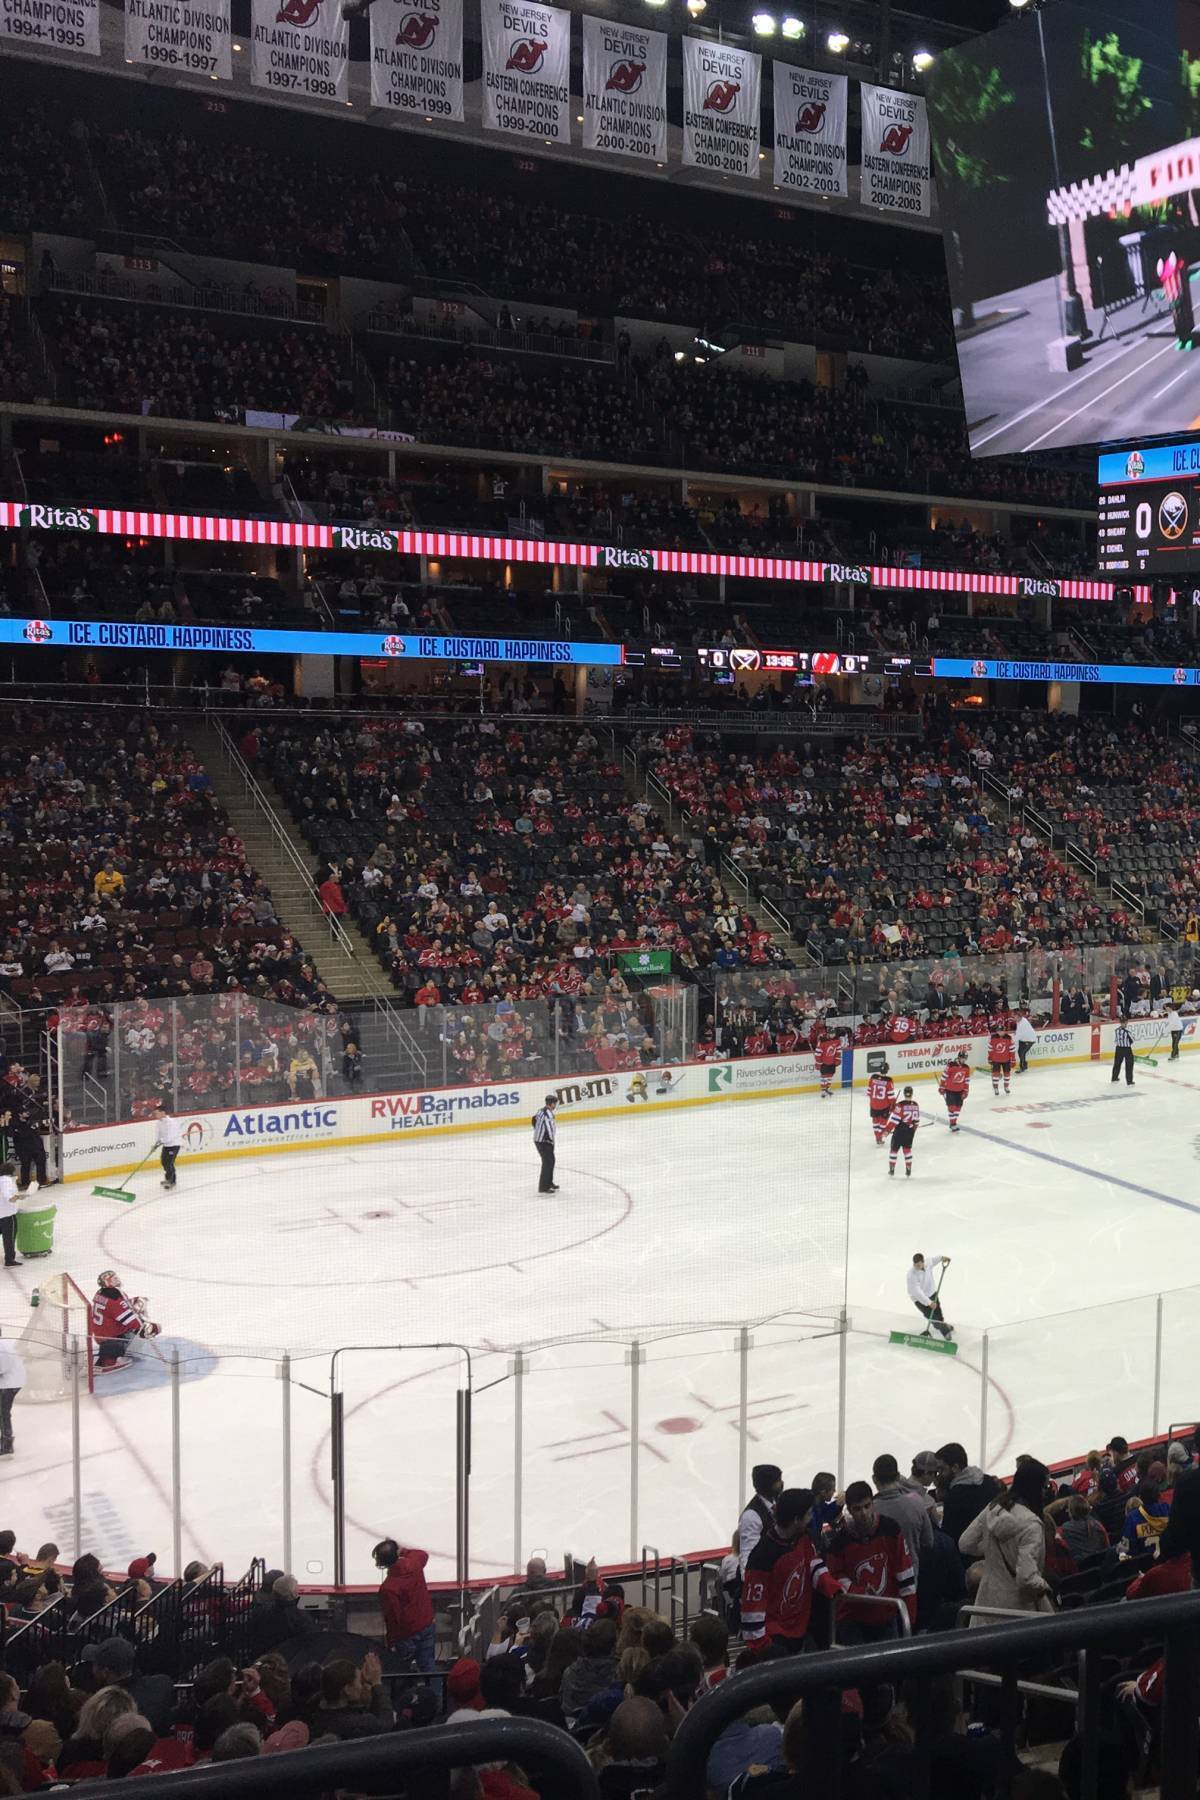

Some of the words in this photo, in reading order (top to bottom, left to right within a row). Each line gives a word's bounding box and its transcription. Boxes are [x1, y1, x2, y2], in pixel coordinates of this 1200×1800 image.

[3, 0, 85, 28] CHAMPIONS
[129, 2, 181, 26] ATLANTIC
[184, 9, 230, 34] DIVISION
[499, 3, 520, 15] NEW
[520, 8, 553, 23] JERSEY
[4, 18, 86, 47] 1994-1995
[503, 15, 549, 38] DEVILS
[600, 26, 619, 38] NEW
[620, 31, 650, 45] JERSEY
[148, 25, 212, 51] CHAMPIONS
[255, 24, 301, 51] ATLANTIC
[304, 34, 348, 59] DIVISION
[604, 38, 647, 60] DEVILS
[143, 45, 218, 72] 1996-1997
[270, 52, 330, 77] CHAMPIONS
[374, 47, 418, 73] ATLANTIC
[420, 56, 461, 79] DIVISION
[698, 47, 717, 59] NEW
[717, 52, 746, 66] JERSEY
[702, 59, 742, 80] DEVILS
[789, 71, 805, 84] NEW
[806, 76, 833, 89] JERSEY
[266, 70, 337, 96] 1997-1998
[391, 71, 447, 97] CHAMPIONS
[486, 72, 518, 93] EASTERN
[519, 79, 568, 104] CONFERENCE
[792, 84, 830, 102] DEVILS
[385, 90, 451, 115] 1998-1999
[495, 94, 559, 121] CHAMPIONS
[585, 93, 627, 116] ATLANTIC
[629, 101, 666, 122] DIVISION
[876, 92, 892, 104] NEW
[892, 98, 918, 110] JERSEY
[878, 104, 915, 123] DEVILS
[496, 114, 559, 137] 1999-2000
[600, 115, 652, 139] CHAMPIONS
[685, 111, 715, 133] EASTERN
[715, 118, 758, 141] CONFERENCE
[596, 134, 657, 156] 2000-2001
[694, 133, 749, 158] CHAMPIONS
[776, 133, 813, 154] ATLANTIC
[813, 142, 846, 160] DIVISION
[695, 152, 748, 174] 2000-2001
[788, 155, 833, 177] CHAMPIONS
[863, 154, 890, 174] EASTERN
[890, 161, 929, 181] CONFERENCE
[782, 171, 840, 193] 2002-2003
[870, 174, 922, 197] CHAMPIONS
[871, 191, 922, 212] 2002-2003
[1173, 450, 1189, 472] ICE.
[30, 503, 91, 531] Rita's
[1136, 502, 1152, 538] 0
[340, 526, 393, 551] Rita's
[605, 547, 650, 570] Rita's
[829, 563, 868, 584] Rita's
[1024, 577, 1057, 597] Rita's
[68, 622, 95, 644] ICE.
[98, 624, 170, 647] CUSTARD.
[172, 626, 256, 650] HAPPINESS.
[418, 637, 442, 657] ICE.
[443, 638, 503, 659] CUSTARD.
[504, 639, 574, 662] HAPPINESS.
[713, 652, 722, 666] 0
[765, 654, 794, 667] 13:35
[996, 662, 1011, 678] ICE.
[1012, 663, 1053, 680] CUSTARD.
[1053, 665, 1101, 681] HAPPINESS.
[895, 1020, 909, 1033] 39
[1043, 1032, 1075, 1043] COAST
[898, 1048, 931, 1059] STREAM
[944, 1043, 973, 1053] GAMES
[1059, 1044, 1075, 1054] GAS
[736, 1067, 776, 1079] Riverside
[776, 1063, 795, 1074] Oral
[907, 1060, 923, 1070] LIVE
[872, 1084, 887, 1099] 13
[223, 1105, 337, 1138] Atlantic
[391, 1112, 454, 1130] HEALTH
[745, 1583, 764, 1601] 13
